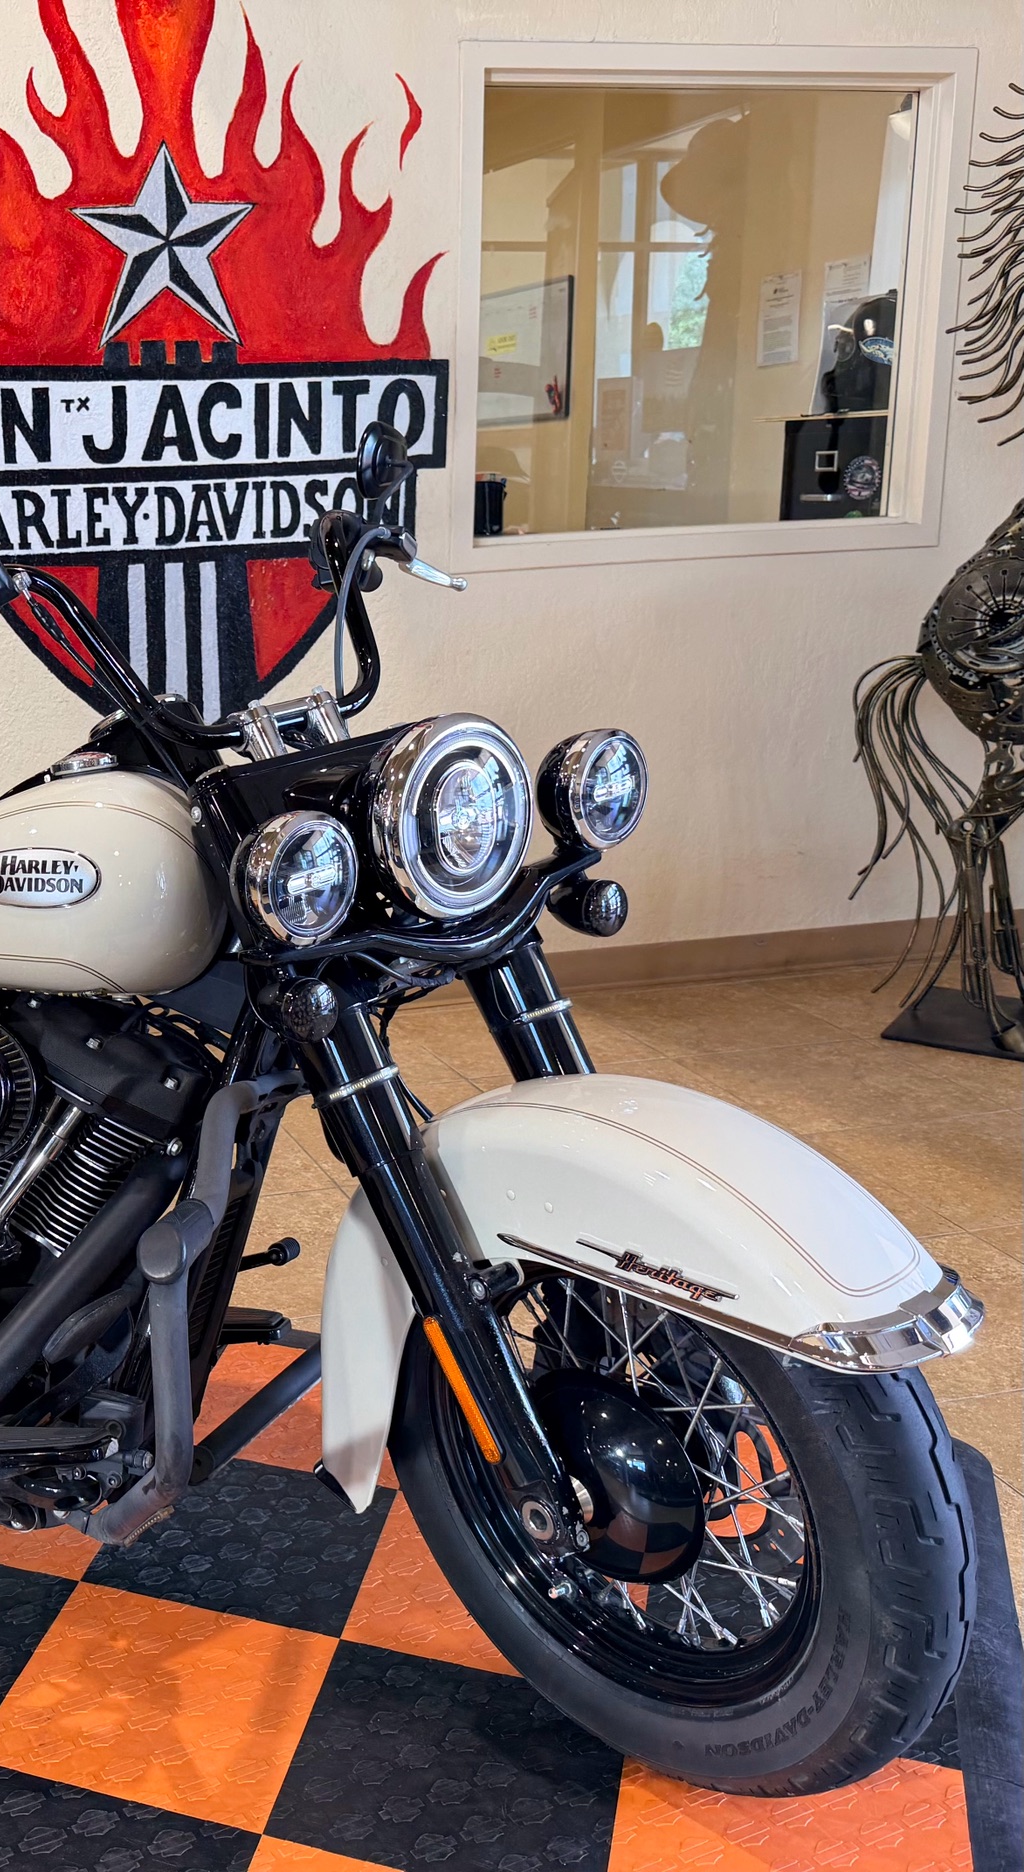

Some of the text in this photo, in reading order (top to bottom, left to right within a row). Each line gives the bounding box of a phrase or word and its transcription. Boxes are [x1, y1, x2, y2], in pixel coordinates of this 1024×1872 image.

[60, 396, 90, 413] TX
[82, 378, 426, 464] JACINTO
[615, 1249, 723, 1302] Heritage
